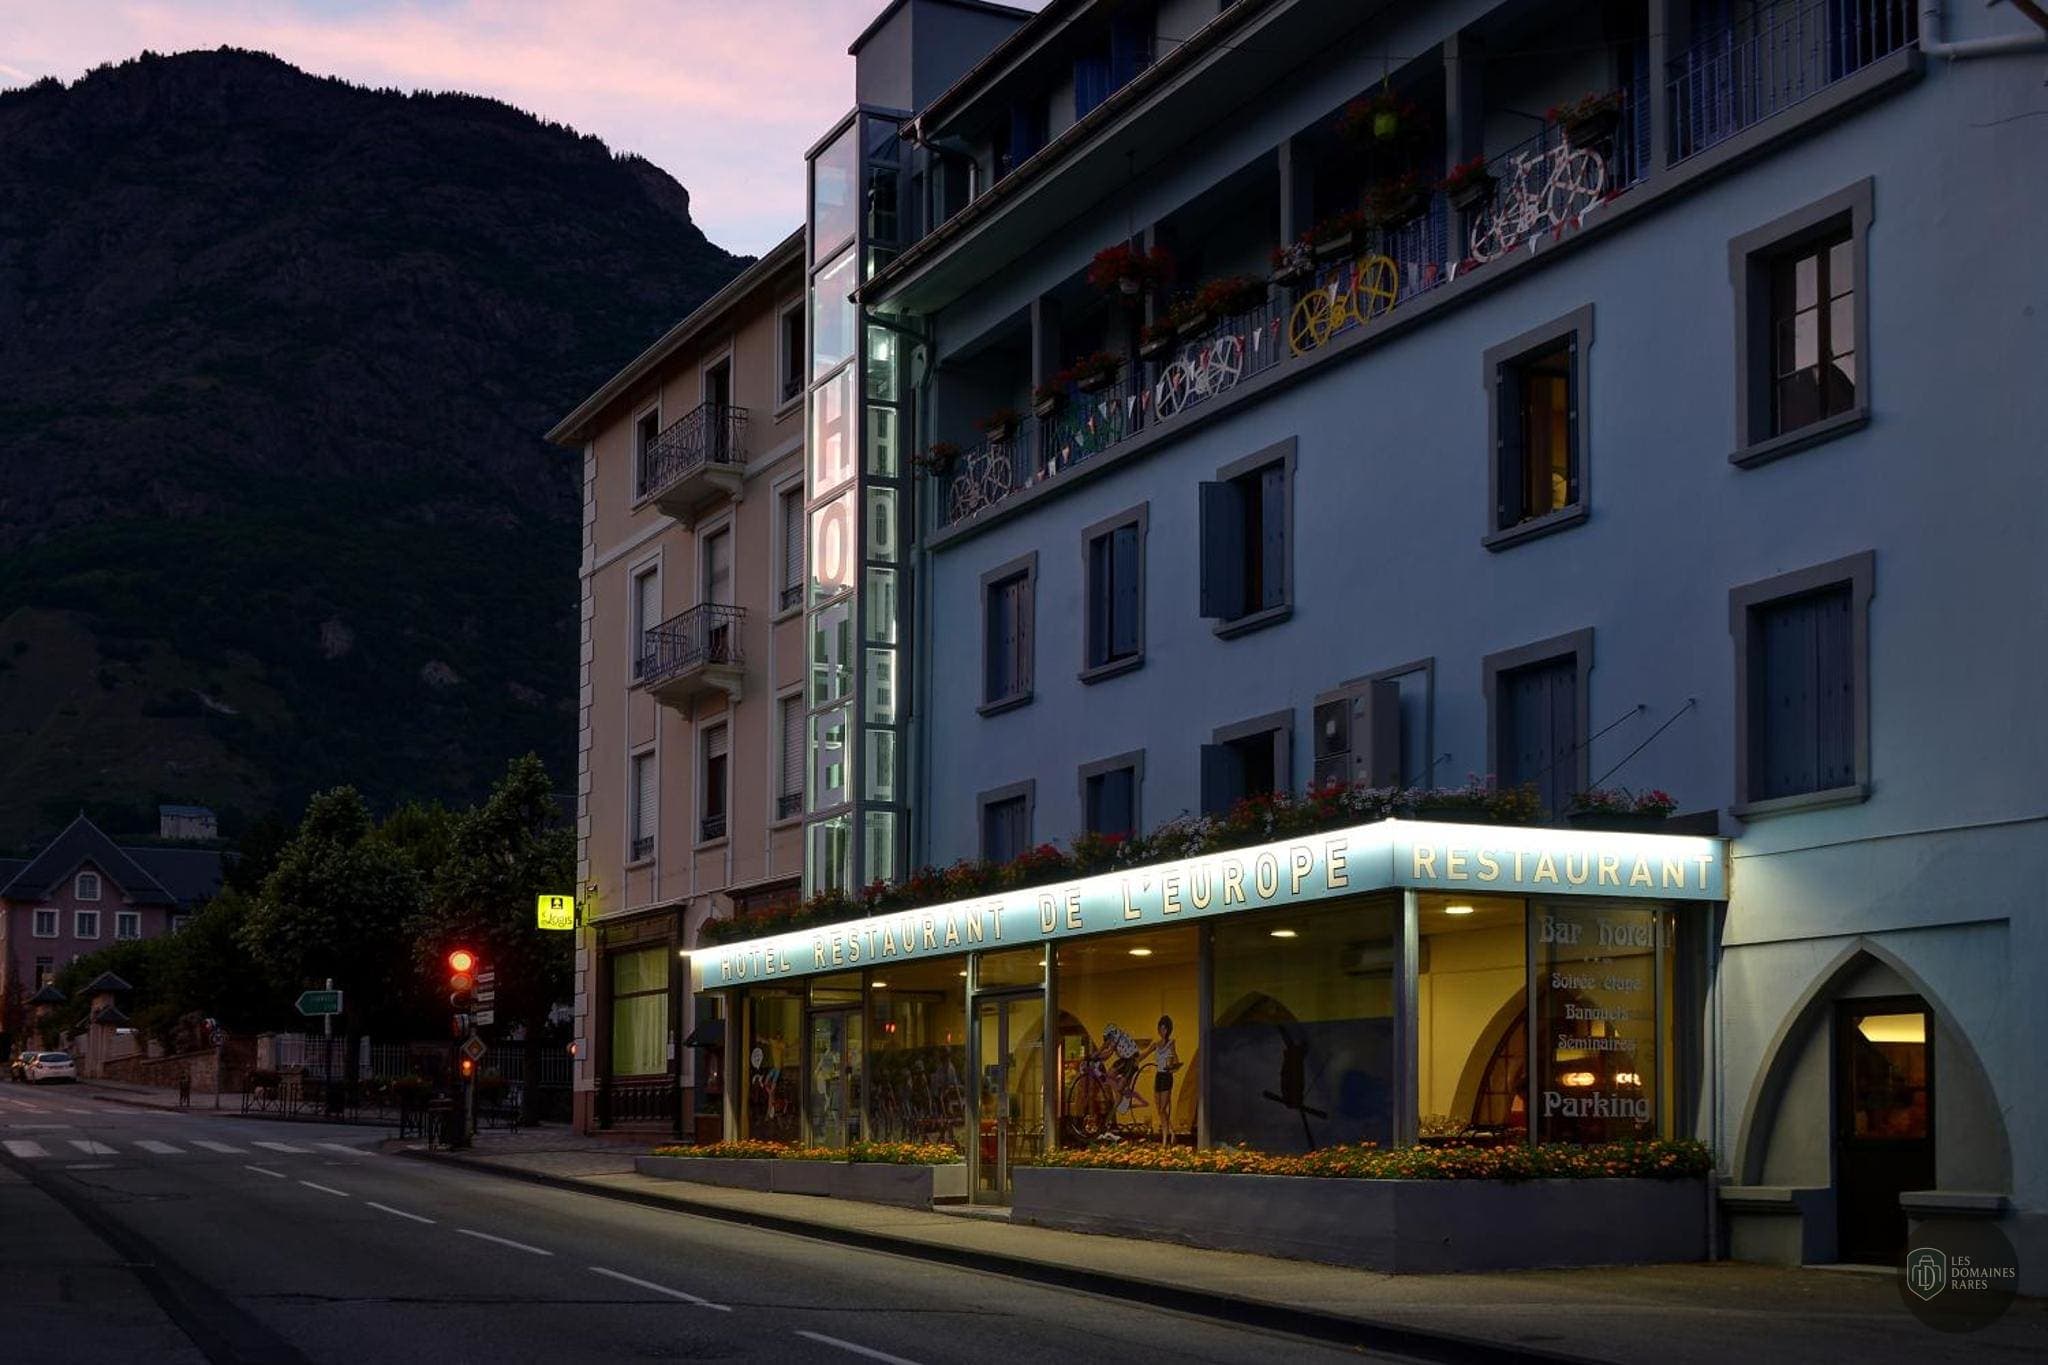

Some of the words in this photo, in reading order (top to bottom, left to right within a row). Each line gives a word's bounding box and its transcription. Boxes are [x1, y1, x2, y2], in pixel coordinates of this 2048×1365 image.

[1412, 843, 1713, 890] RESTAURANT
[721, 940, 790, 981] HOTEL
[813, 901, 1005, 969] RESTAURANT
[1038, 887, 1083, 934] DE
[1121, 838, 1349, 920] L'EUROPE
[1539, 915, 1582, 944] Bar
[1544, 1091, 1649, 1123] Parking
